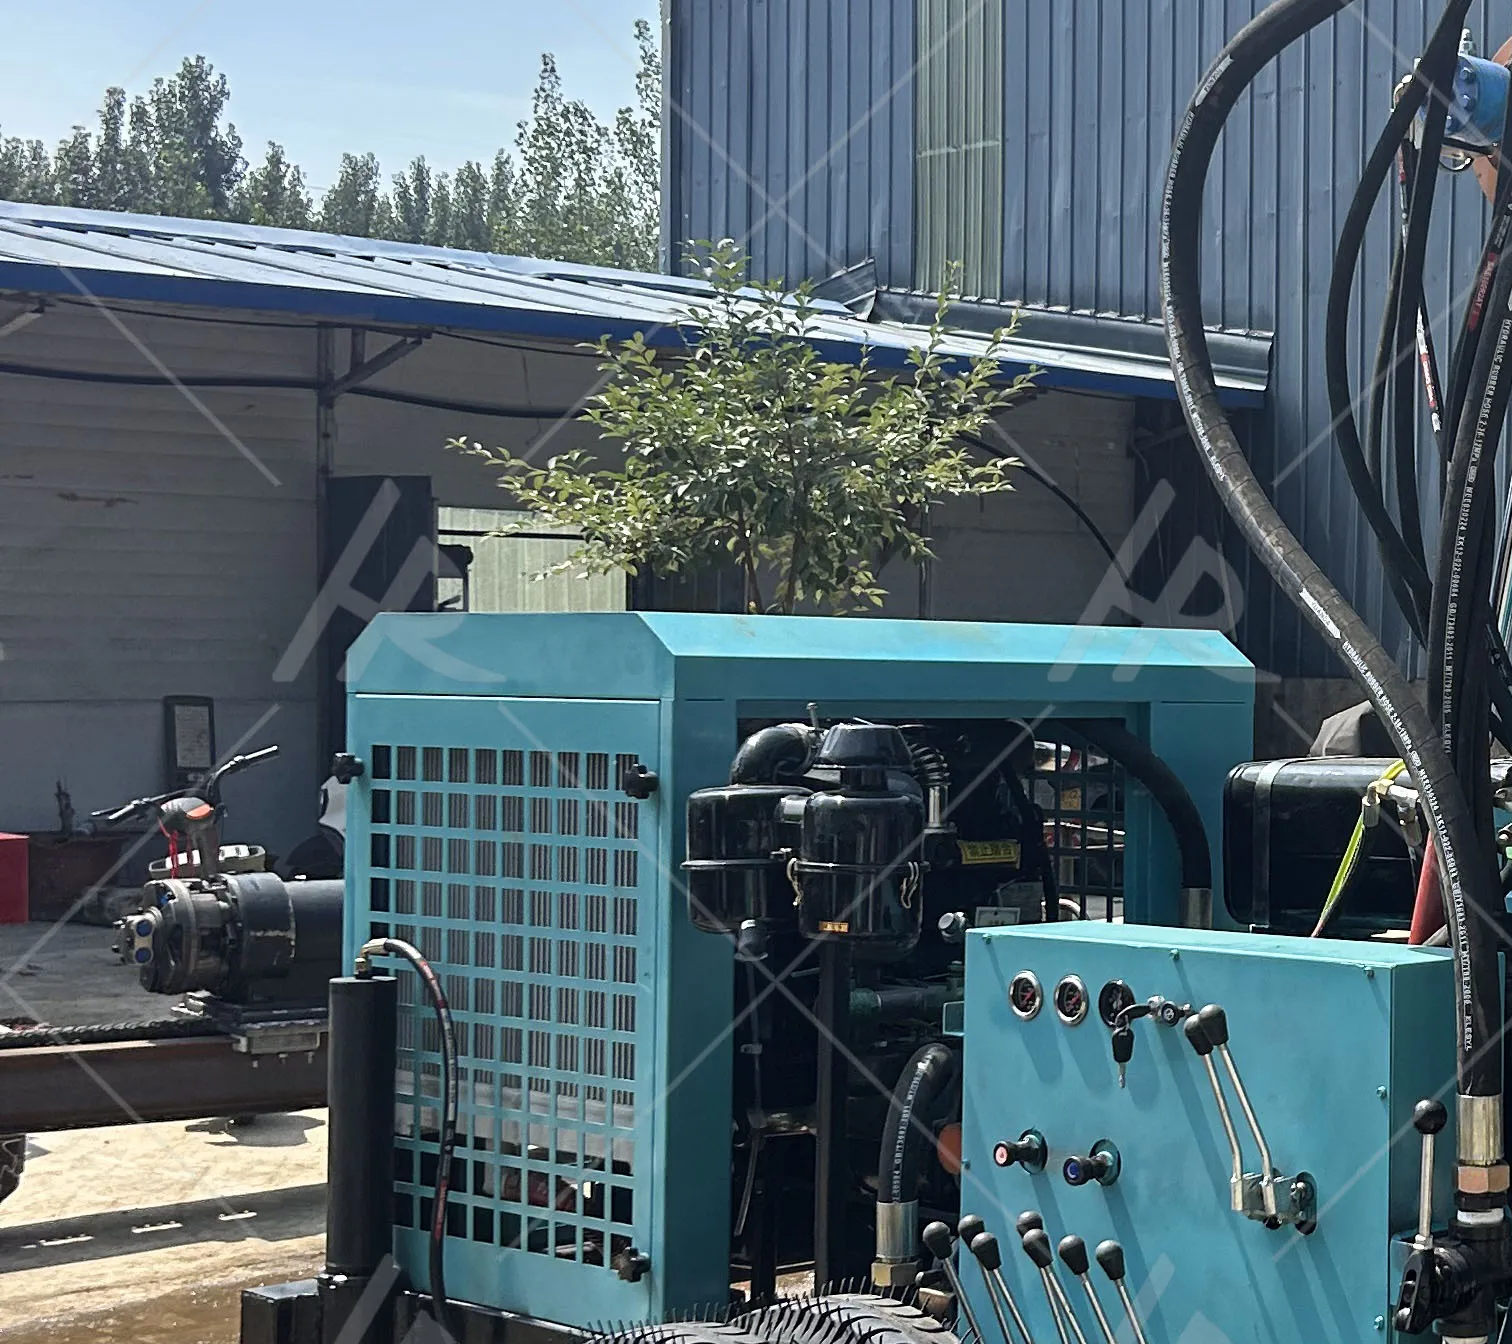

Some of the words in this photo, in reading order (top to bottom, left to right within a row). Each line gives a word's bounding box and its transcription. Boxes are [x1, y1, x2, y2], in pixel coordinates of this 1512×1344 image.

[1493, 318, 1512, 364] HYDRAULIC
[1485, 364, 1502, 396] RUBBER
[1479, 397, 1493, 418] HOSE
